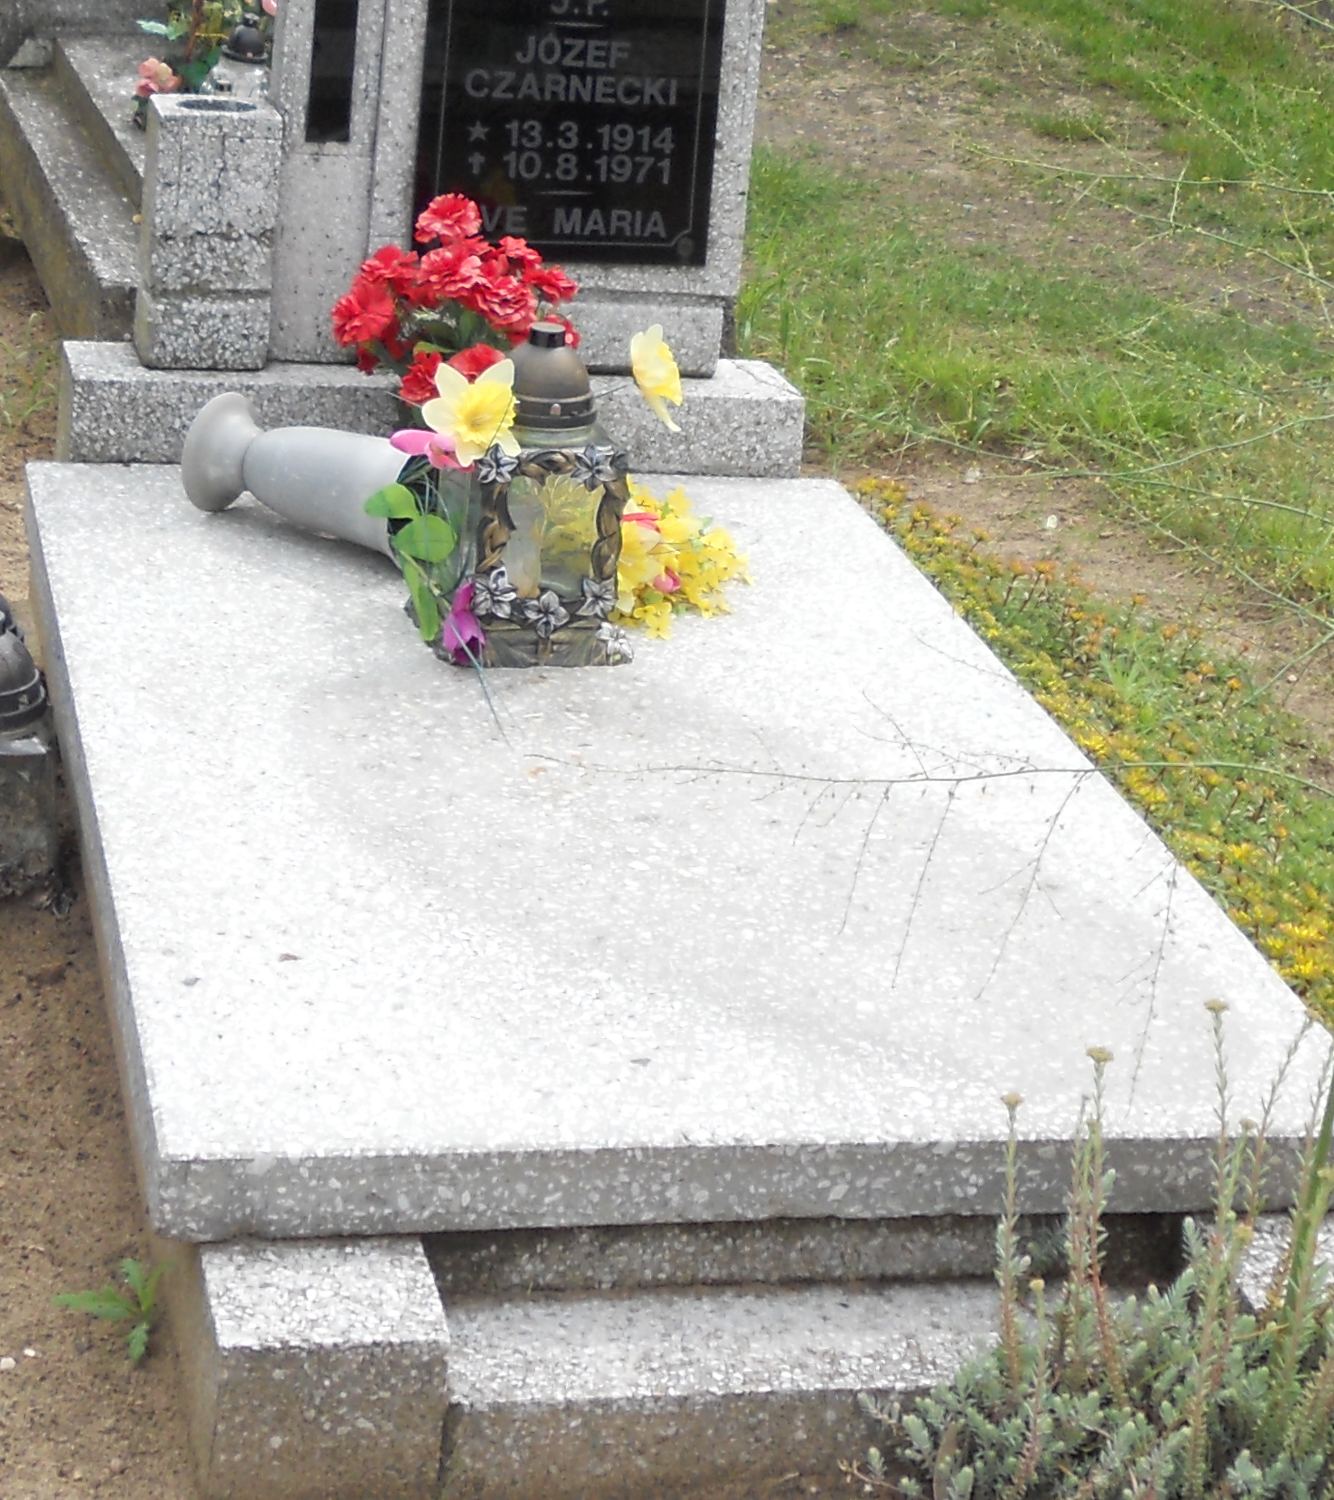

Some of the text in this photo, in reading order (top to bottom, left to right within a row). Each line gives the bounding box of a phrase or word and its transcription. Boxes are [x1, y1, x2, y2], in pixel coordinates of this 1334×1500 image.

[515, 33, 631, 69] JÓZEF
[466, 68, 678, 106] CZARNECKI
[480, 205, 667, 238] VE MARIA
